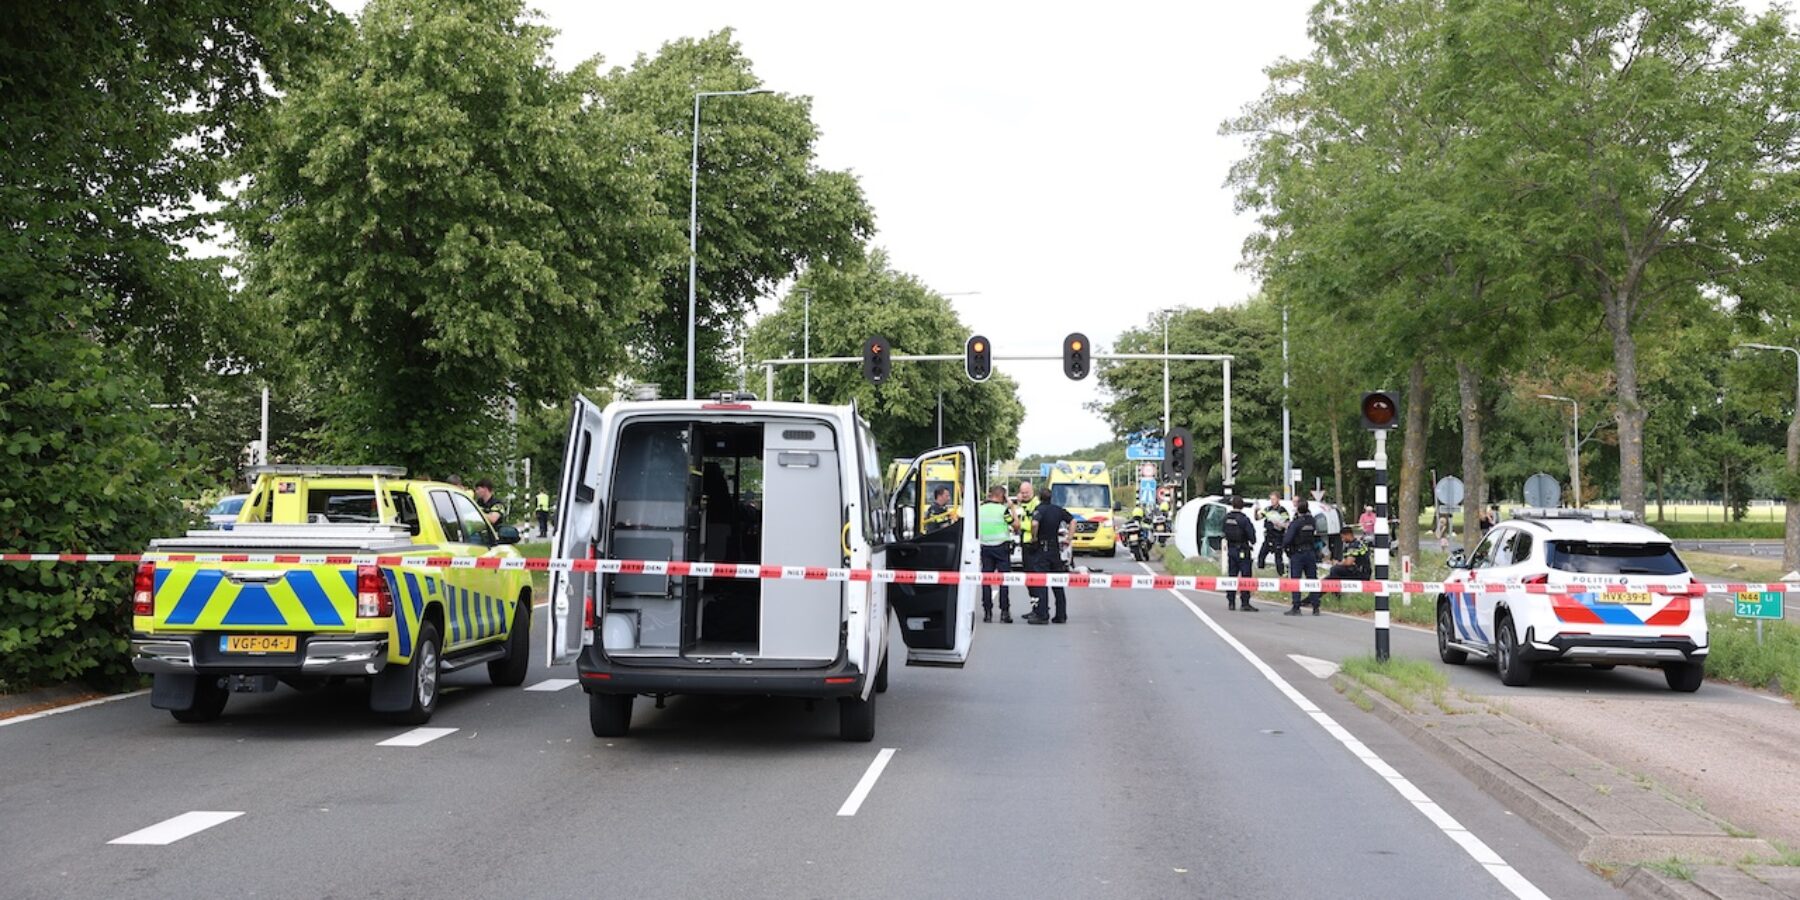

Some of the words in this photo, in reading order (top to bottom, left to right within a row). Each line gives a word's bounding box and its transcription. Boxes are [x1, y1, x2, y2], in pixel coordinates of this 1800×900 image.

[1602, 593, 1648, 601] HVX-39-F
[1740, 593, 1759, 601] N44
[232, 637, 291, 650] VGF-04-J
